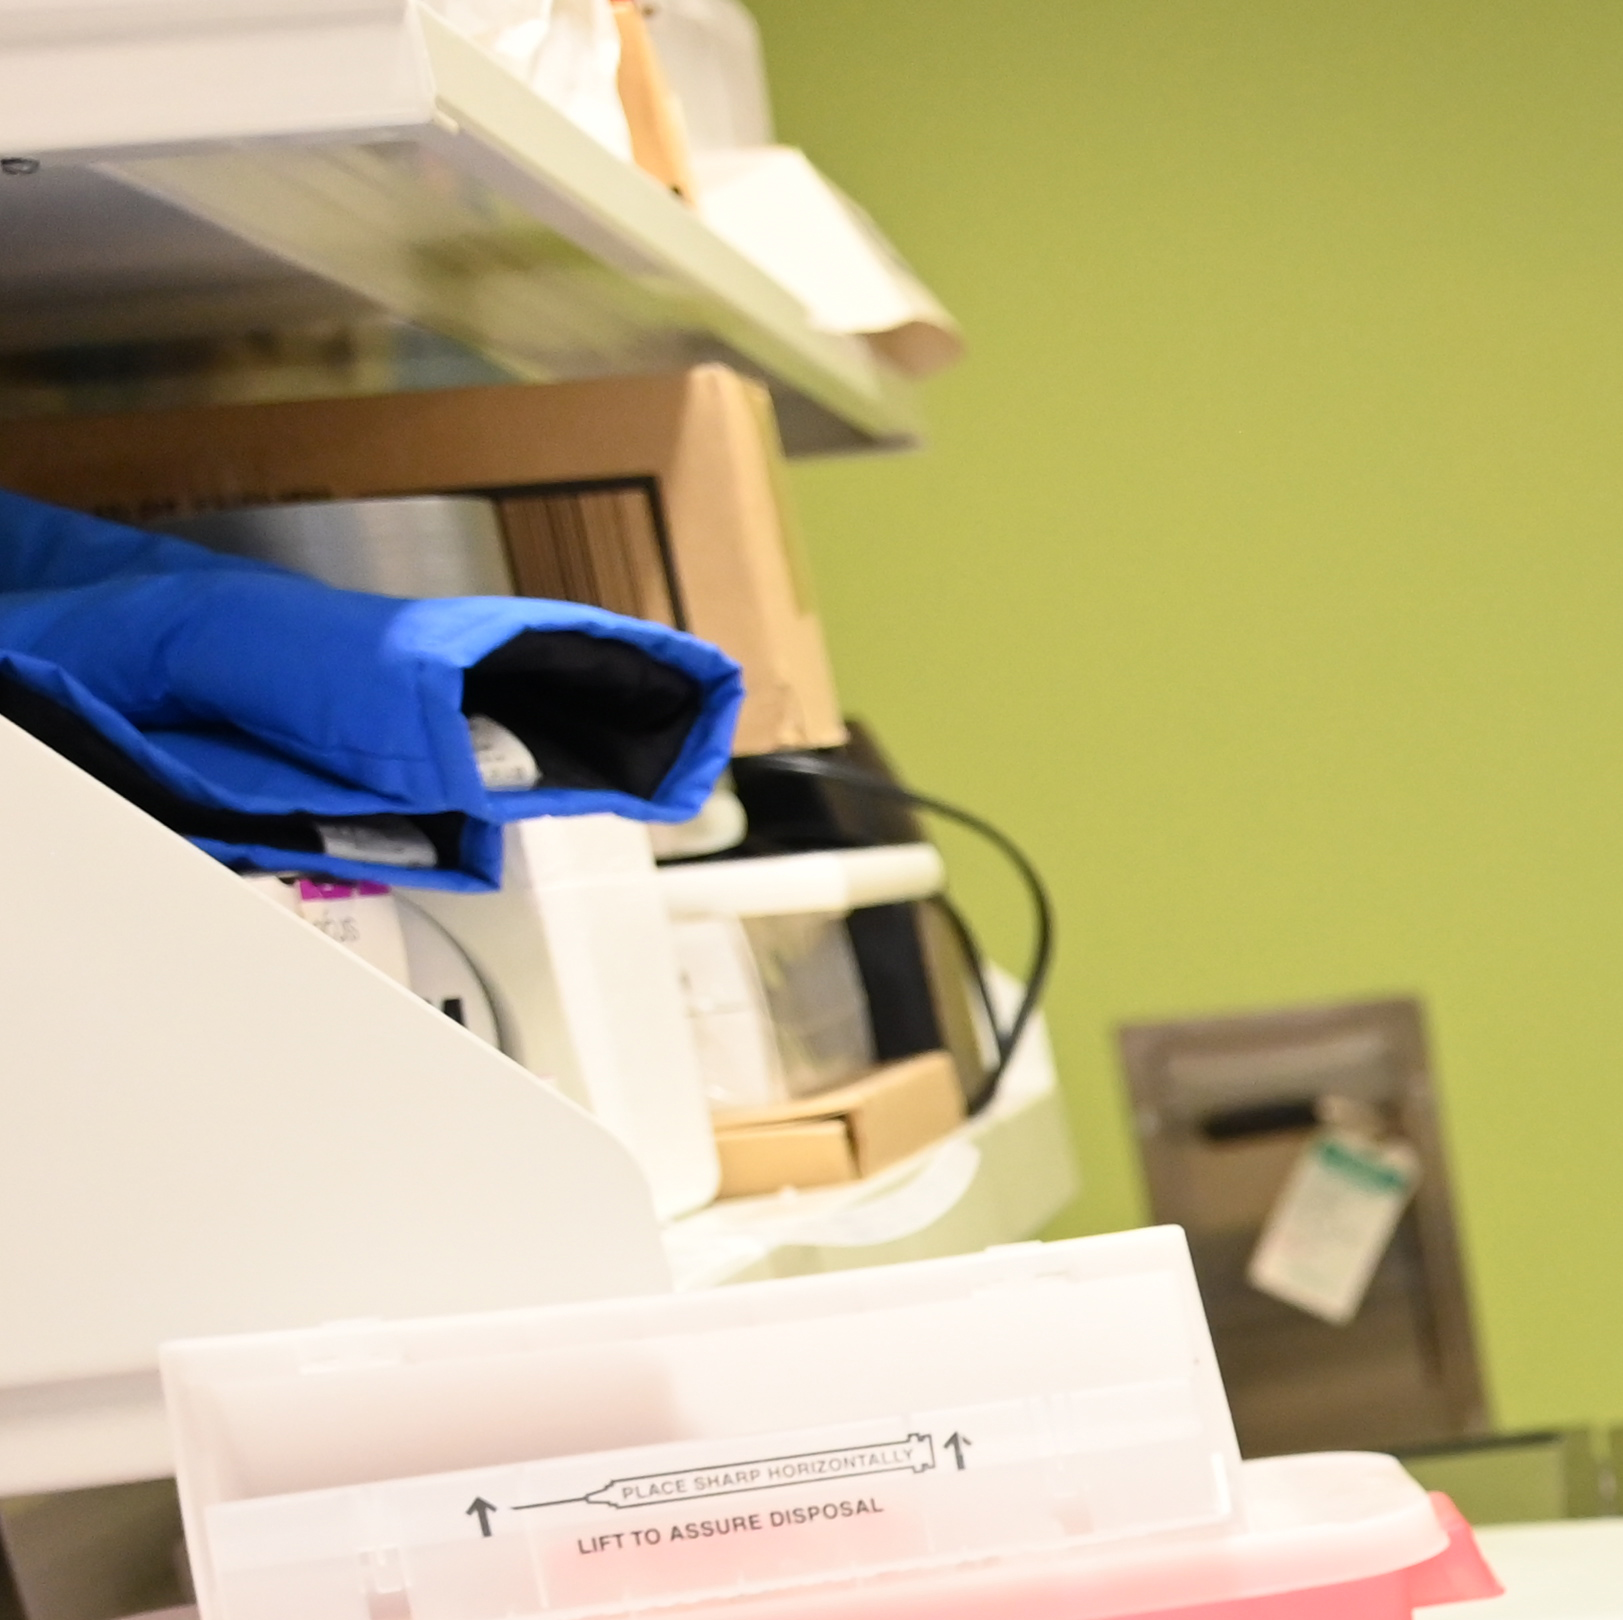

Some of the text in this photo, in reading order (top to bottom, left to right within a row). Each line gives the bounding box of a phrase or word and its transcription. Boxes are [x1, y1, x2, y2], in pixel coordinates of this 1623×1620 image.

[620, 1449, 914, 1502] PLACE SHARP HORIZONTALLY
[577, 1498, 883, 1555] LIFT TO ASSURE DISPOSAL
